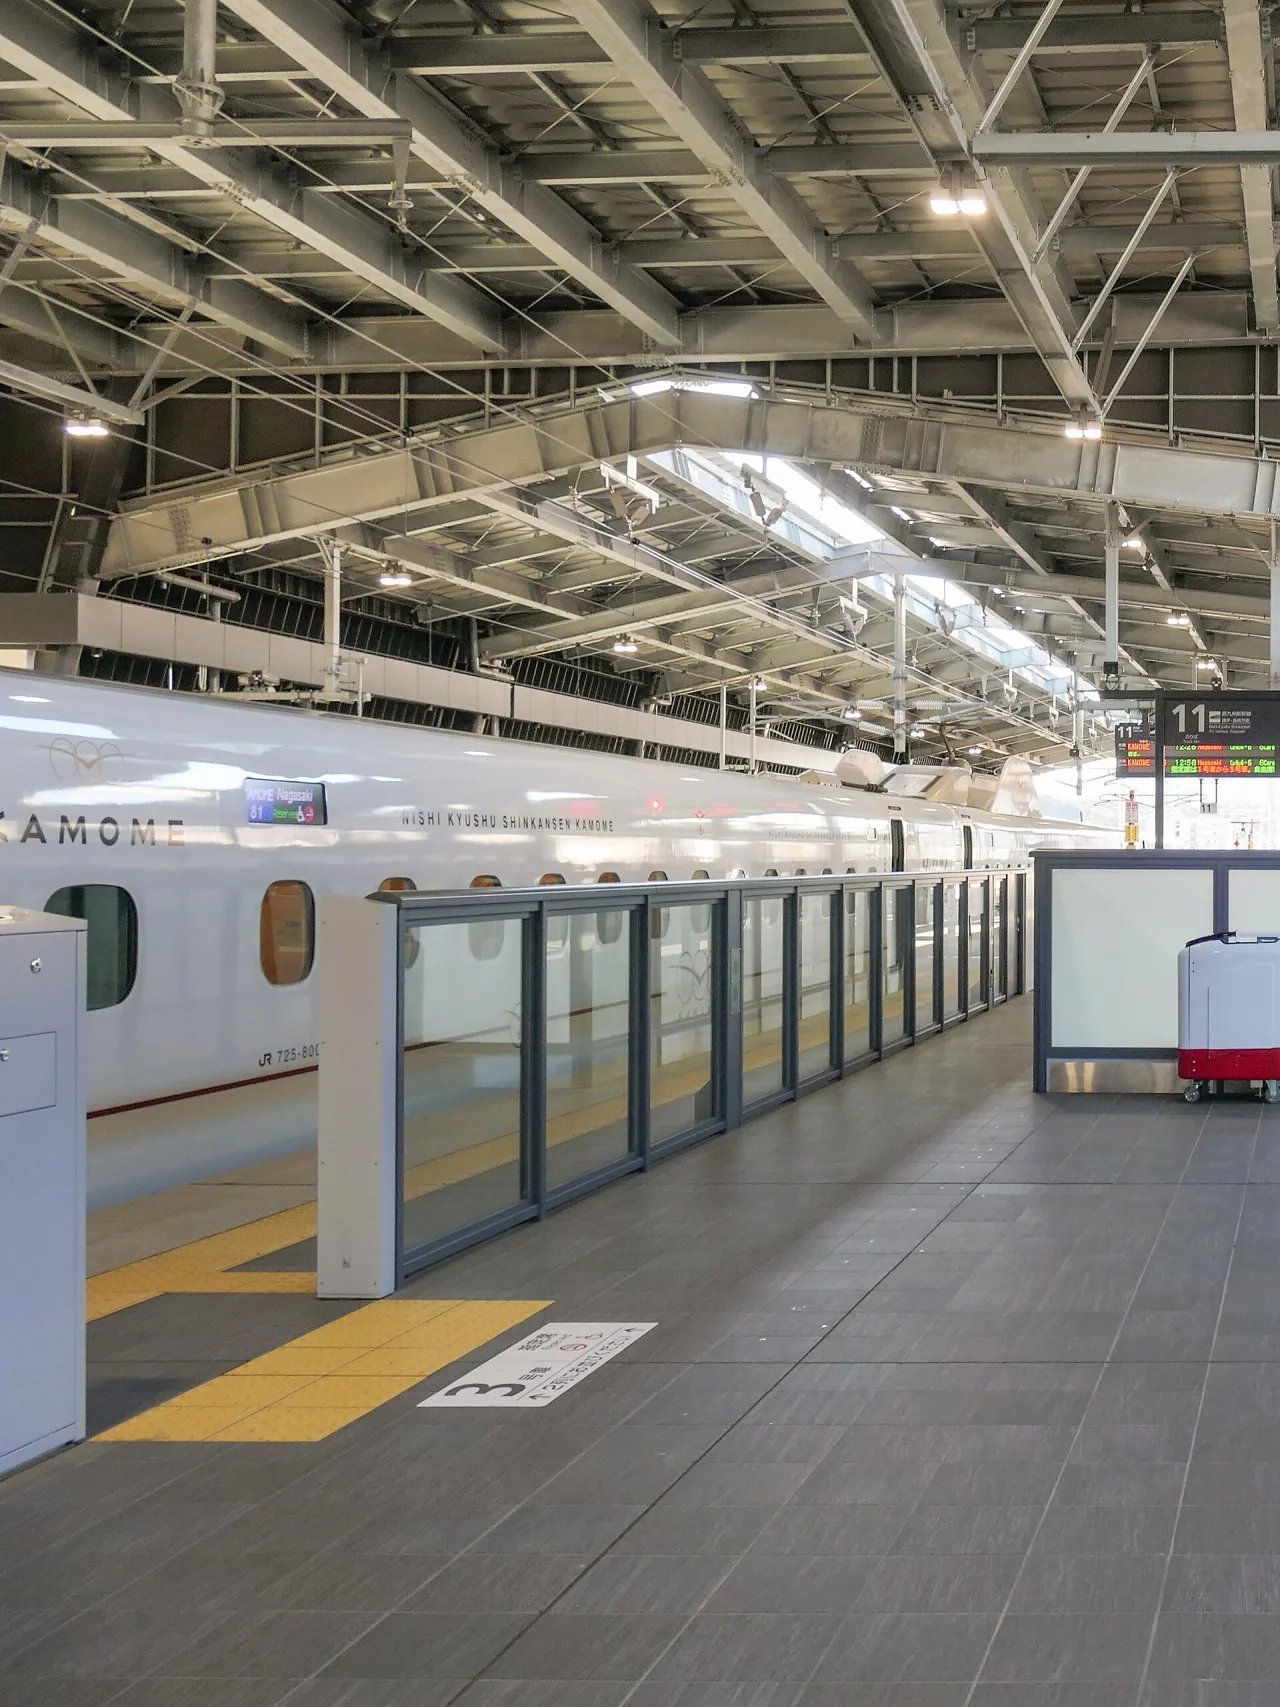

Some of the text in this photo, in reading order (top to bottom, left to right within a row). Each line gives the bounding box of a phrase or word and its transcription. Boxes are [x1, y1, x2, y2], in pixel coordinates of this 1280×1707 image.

[1171, 704, 1205, 733] 11
[1118, 726, 1132, 738] 11
[276, 787, 313, 804] Nagasaki
[250, 805, 263, 819] 81
[1201, 804, 1211, 812] 11
[402, 811, 614, 832] NISHI KYUSHU SHINKANSEN KAMOME
[443, 1382, 526, 1397] 3
